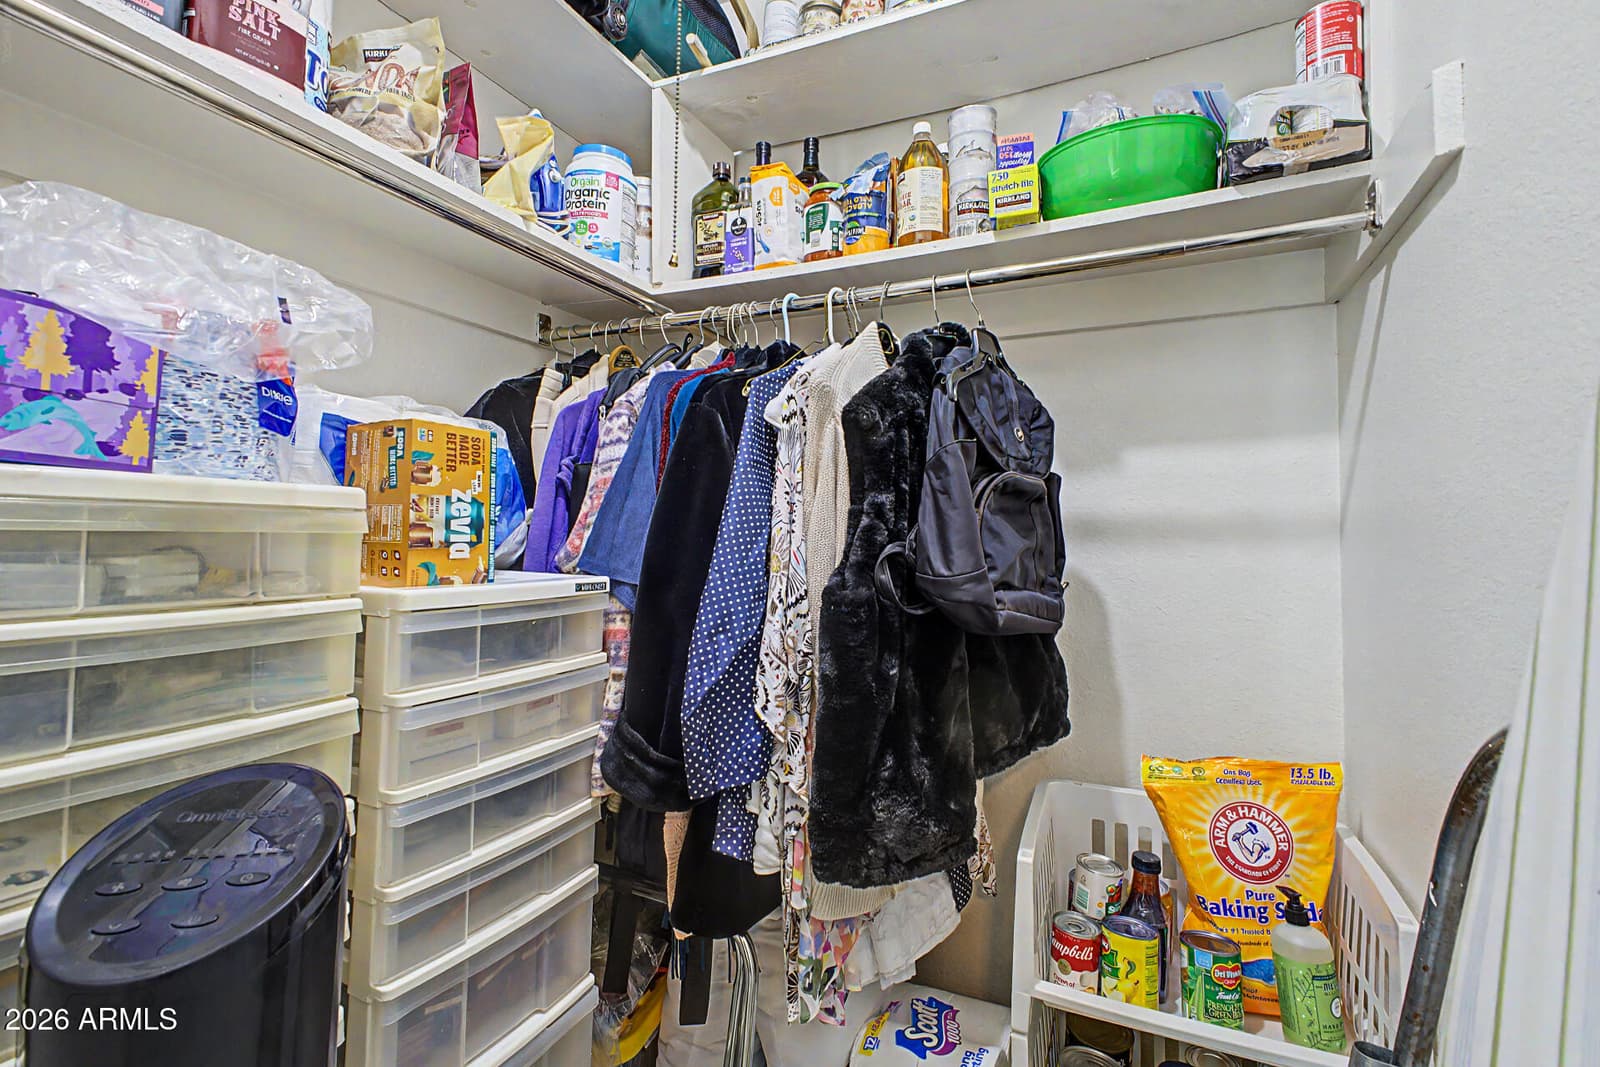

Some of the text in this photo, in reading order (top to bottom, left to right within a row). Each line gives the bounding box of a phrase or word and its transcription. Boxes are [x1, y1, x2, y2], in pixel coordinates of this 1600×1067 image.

[228, 5, 281, 40] SALT
[364, 49, 388, 58] KIRKL
[570, 177, 600, 188] Orgain
[991, 171, 1009, 184] 750
[958, 200, 989, 210] KIRKLAN
[997, 193, 1031, 204] KIRKLAND
[446, 432, 457, 473] BETTER
[458, 434, 470, 466] MADE
[471, 436, 482, 466] SODA
[449, 488, 474, 560] zevia
[1290, 767, 1334, 780] 13.5 lb.
[1214, 806, 1289, 851] ARM & HAMMER
[1245, 890, 1275, 902] Pure
[1196, 894, 1269, 925] Baking
[904, 998, 939, 1048] Scott
[947, 1020, 962, 1045] 1000
[864, 1036, 878, 1051] 12
